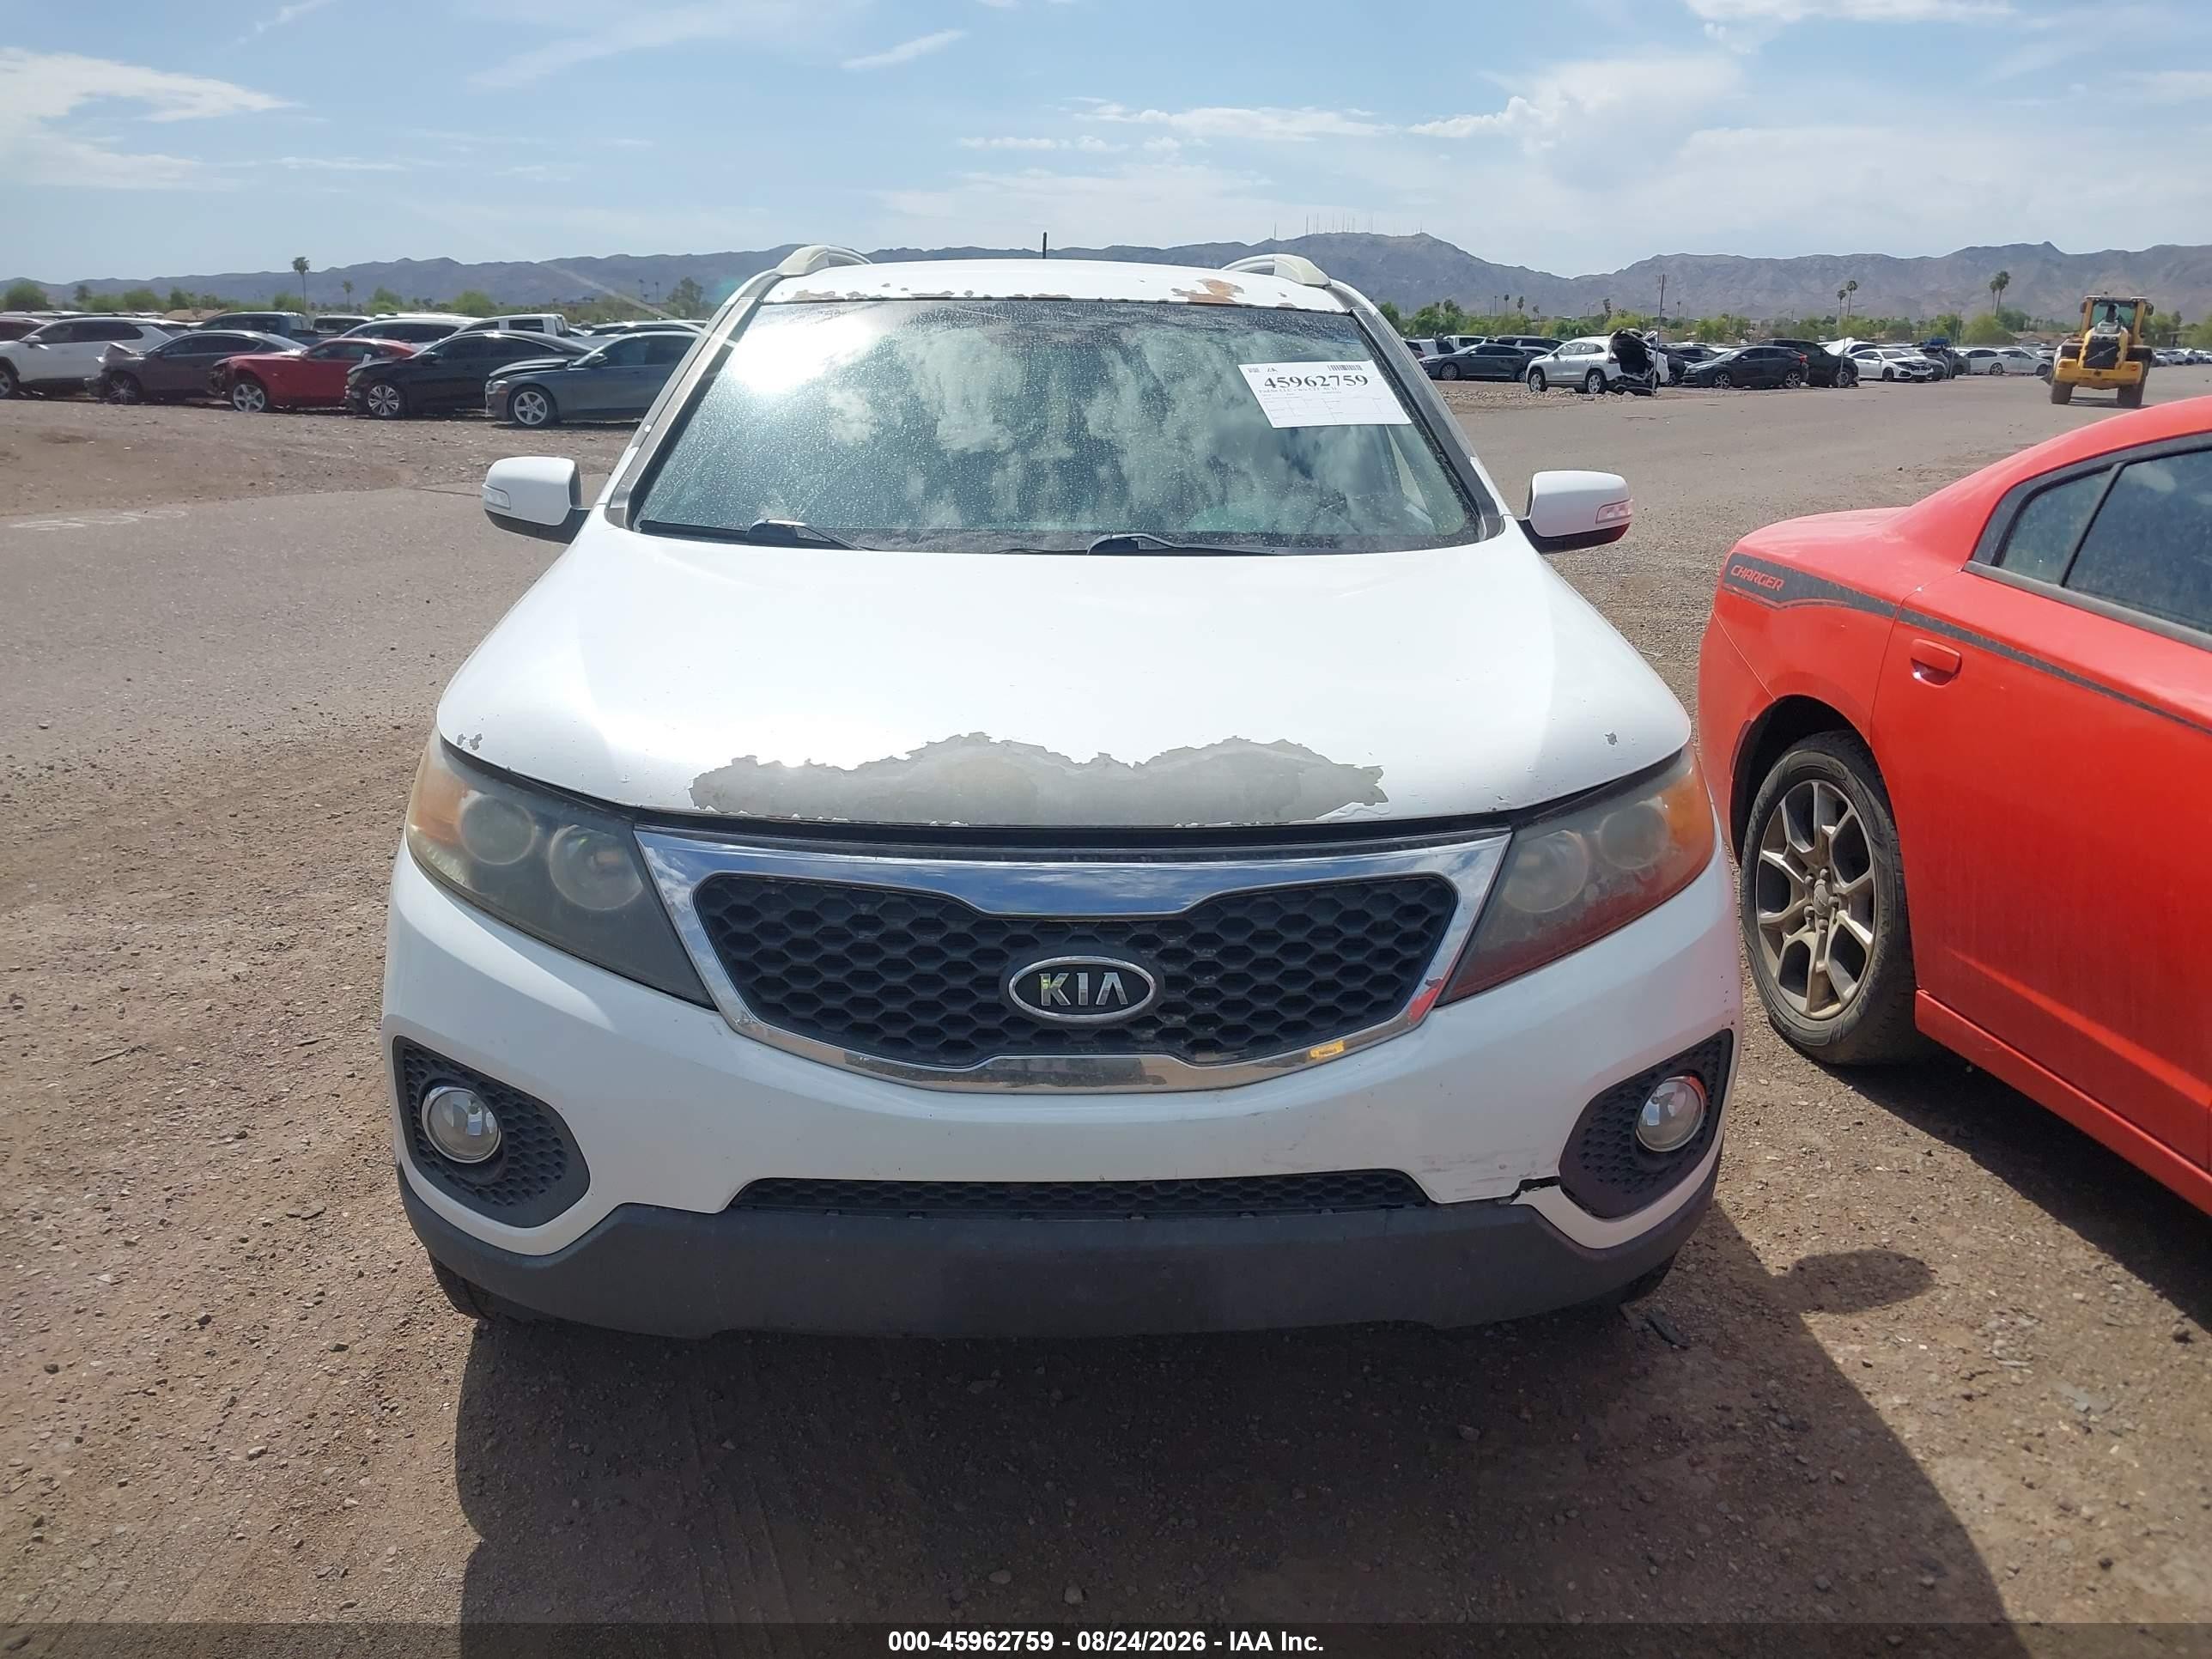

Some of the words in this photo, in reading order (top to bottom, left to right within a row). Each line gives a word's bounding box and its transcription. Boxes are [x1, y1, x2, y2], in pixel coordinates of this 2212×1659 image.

[1264, 375, 1368, 388] 45962759
[1731, 565, 1784, 591] CHARGER
[1039, 972, 1128, 1006] KIA
